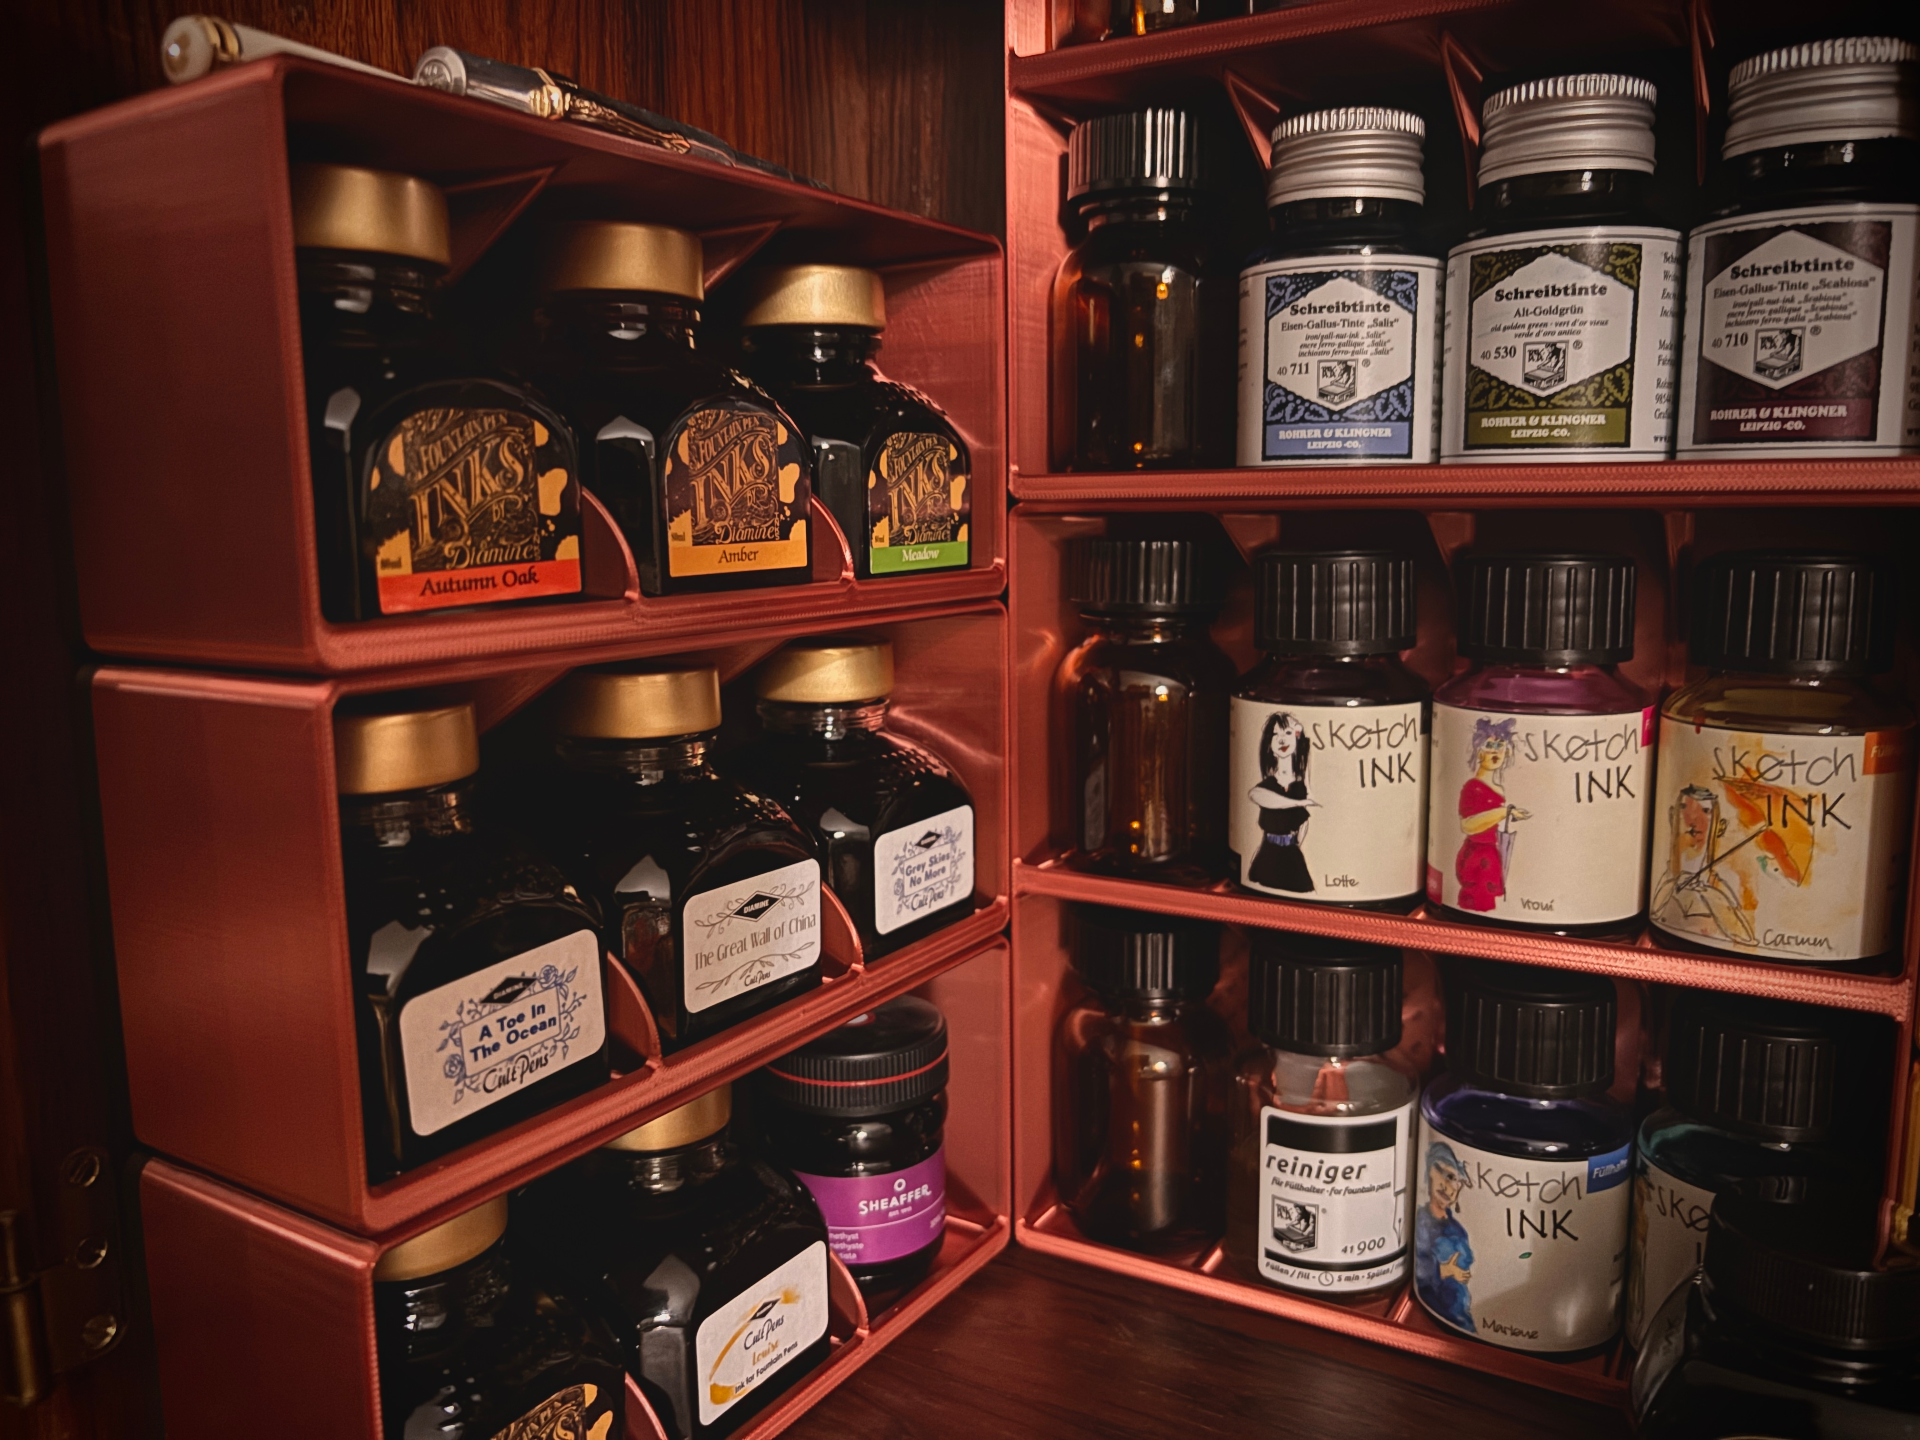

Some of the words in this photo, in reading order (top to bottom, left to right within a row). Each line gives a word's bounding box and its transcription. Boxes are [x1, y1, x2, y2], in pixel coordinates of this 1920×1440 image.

[1730, 257, 1854, 280] Schreibtinte
[1494, 283, 1608, 302] Schreibtinte
[1713, 280, 1809, 299] Eisen-Gallus-Tinte
[1290, 300, 1391, 316] Schreibtinte
[1514, 304, 1584, 318] Alt-Goldgrün
[1281, 319, 1365, 332] Eisen-Gallus-Tinte
[1490, 323, 1502, 332] old
[1502, 321, 1526, 333] golden
[1527, 322, 1549, 331] green
[1554, 320, 1570, 328] vert
[1514, 331, 1533, 339] verde
[1557, 329, 1582, 337] antico
[1712, 337, 1722, 349] 40
[1725, 332, 1748, 348] 710
[1480, 350, 1491, 360] 40
[1494, 345, 1517, 360] 530
[1277, 366, 1287, 376] 40
[1290, 362, 1309, 375] 711
[1481, 416, 1527, 428] ROHRER
[1528, 415, 1540, 427] &
[1541, 414, 1606, 427] KLINGNER
[1710, 408, 1757, 421] ROHRER
[1759, 407, 1771, 419] &
[1772, 405, 1847, 419] KLINGNER
[1279, 429, 1321, 440] ROHRER
[1323, 428, 1333, 438] &
[1335, 428, 1392, 438] KLINGNER
[1511, 429, 1550, 438] LEIPZIG
[1740, 421, 1782, 432] LEIPZIG
[1307, 441, 1342, 449] LEIPZIG
[410, 436, 524, 550] INKS
[690, 435, 770, 530] INKS
[888, 453, 945, 536] INKS
[715, 521, 776, 545] Diamine
[904, 525, 948, 545] Diamine
[443, 542, 535, 570] Diamine
[718, 546, 759, 564] Amber
[902, 545, 940, 562] Meadow
[420, 576, 497, 597] Autumn
[502, 566, 539, 586] Oak
[1359, 751, 1416, 789] INK
[1575, 764, 1636, 804] INK
[1767, 792, 1852, 830] INK
[906, 862, 926, 877] Grey
[929, 852, 951, 868] Skies
[910, 876, 922, 888] No
[924, 866, 947, 882] More
[1325, 874, 1359, 888] Lotte
[743, 899, 770, 915] DIAMINE
[695, 951, 714, 971] The
[717, 937, 747, 963] Great
[750, 926, 771, 949] Wall
[773, 921, 785, 941] of
[789, 913, 817, 936] China
[1763, 929, 1833, 950] Carmen
[479, 1024, 493, 1042] A
[496, 1012, 526, 1033] Toe
[531, 1004, 546, 1019] In
[470, 1041, 501, 1062] The
[506, 1016, 557, 1045] Ocean
[483, 1067, 517, 1094] Cult
[514, 1054, 549, 1084] Pens
[1265, 1155, 1367, 1185] reiniger
[1271, 1176, 1284, 1186] für
[1284, 1180, 1325, 1195] Füllhalter
[1329, 1186, 1342, 1197] for
[1343, 1183, 1376, 1196] fountain
[1375, 1181, 1391, 1193] pens
[858, 1183, 932, 1216] SHEAFFER
[1506, 1208, 1579, 1241] INK
[1341, 1244, 1354, 1254] 41
[1357, 1236, 1386, 1256] 900
[1265, 1261, 1289, 1276] Füllen
[1296, 1270, 1310, 1280] fill
[1337, 1274, 1342, 1282] 5
[1344, 1274, 1360, 1282] min
[744, 1329, 764, 1350] Cult
[762, 1314, 784, 1341] Pens
[735, 1382, 745, 1394] Ink
[746, 1373, 755, 1385] for
[756, 1353, 782, 1377] Fountain
[784, 1341, 798, 1356] Pens
